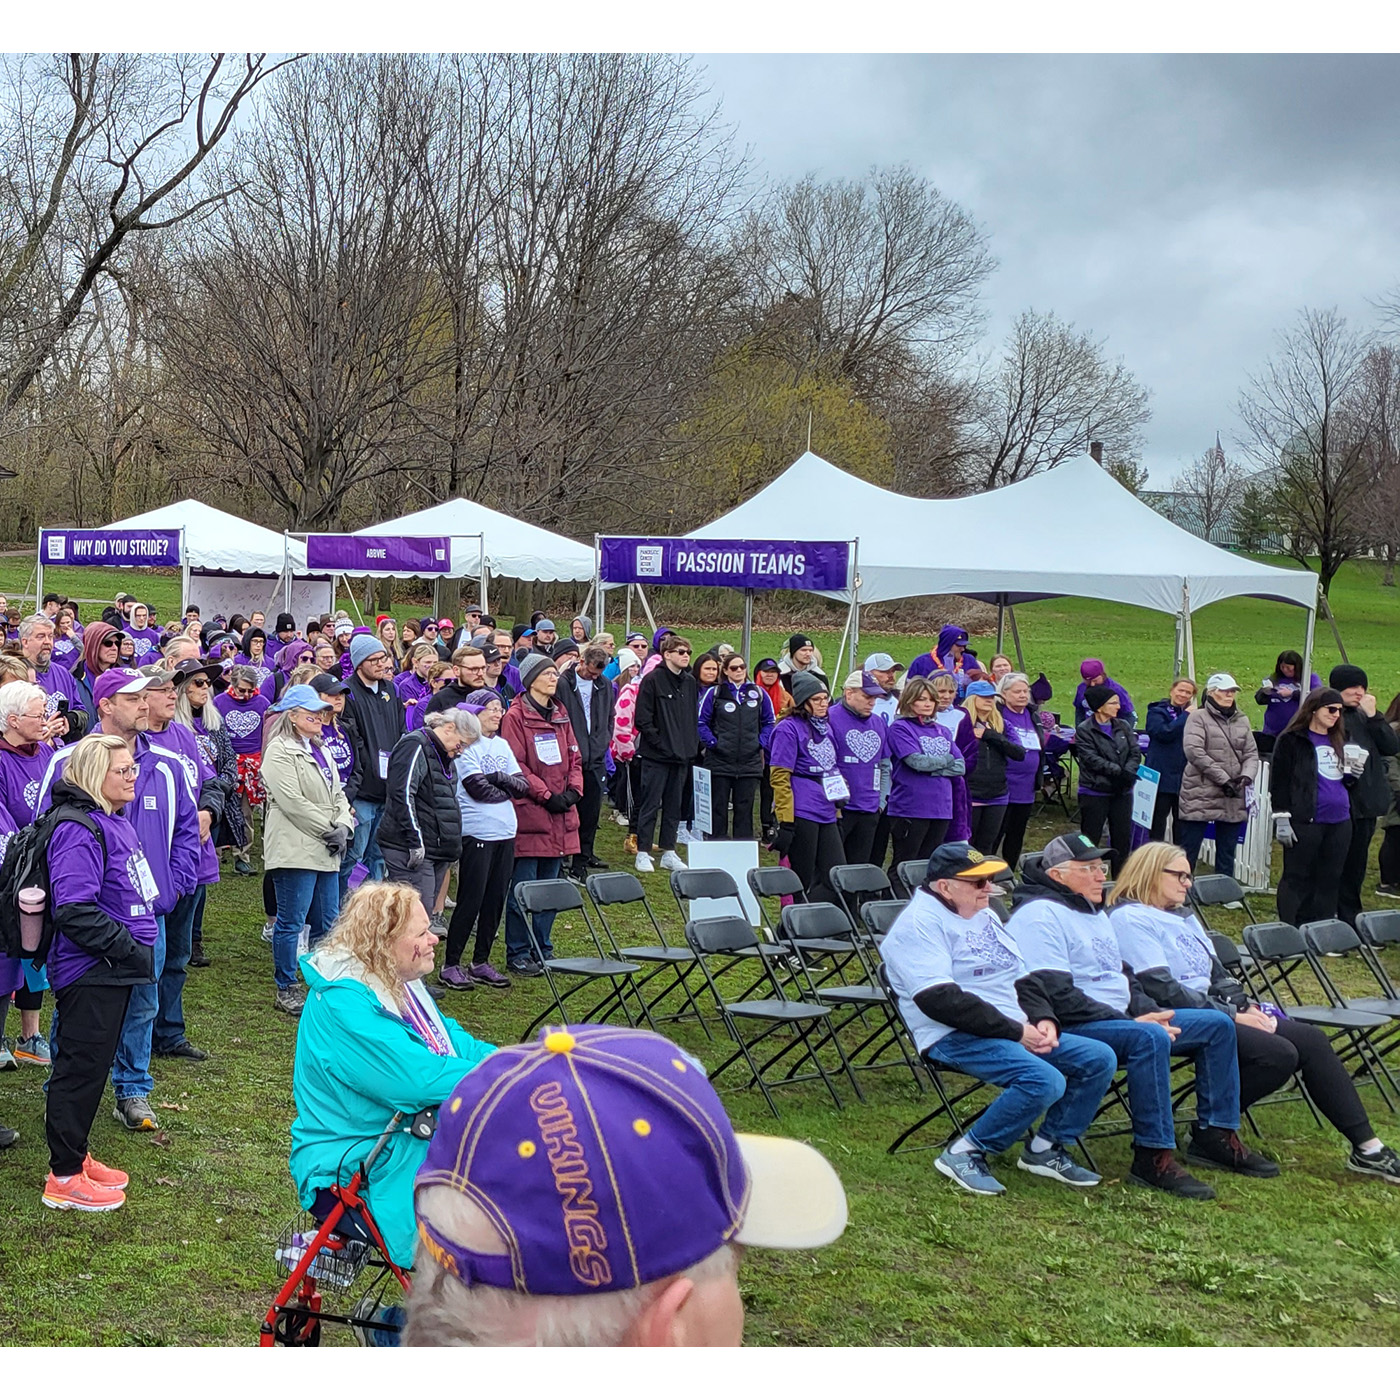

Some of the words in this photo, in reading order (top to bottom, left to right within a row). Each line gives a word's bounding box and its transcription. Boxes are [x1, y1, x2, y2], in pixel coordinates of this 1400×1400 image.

[73, 540, 93, 556] WHY
[95, 540, 107, 555] DO
[109, 540, 127, 555] YOU
[130, 539, 169, 556] STRIDE?
[366, 548, 386, 558] ABBVIE
[677, 552, 744, 573] PASSION
[750, 553, 805, 575] TEAMS
[529, 1081, 612, 1288] VIKINGS
